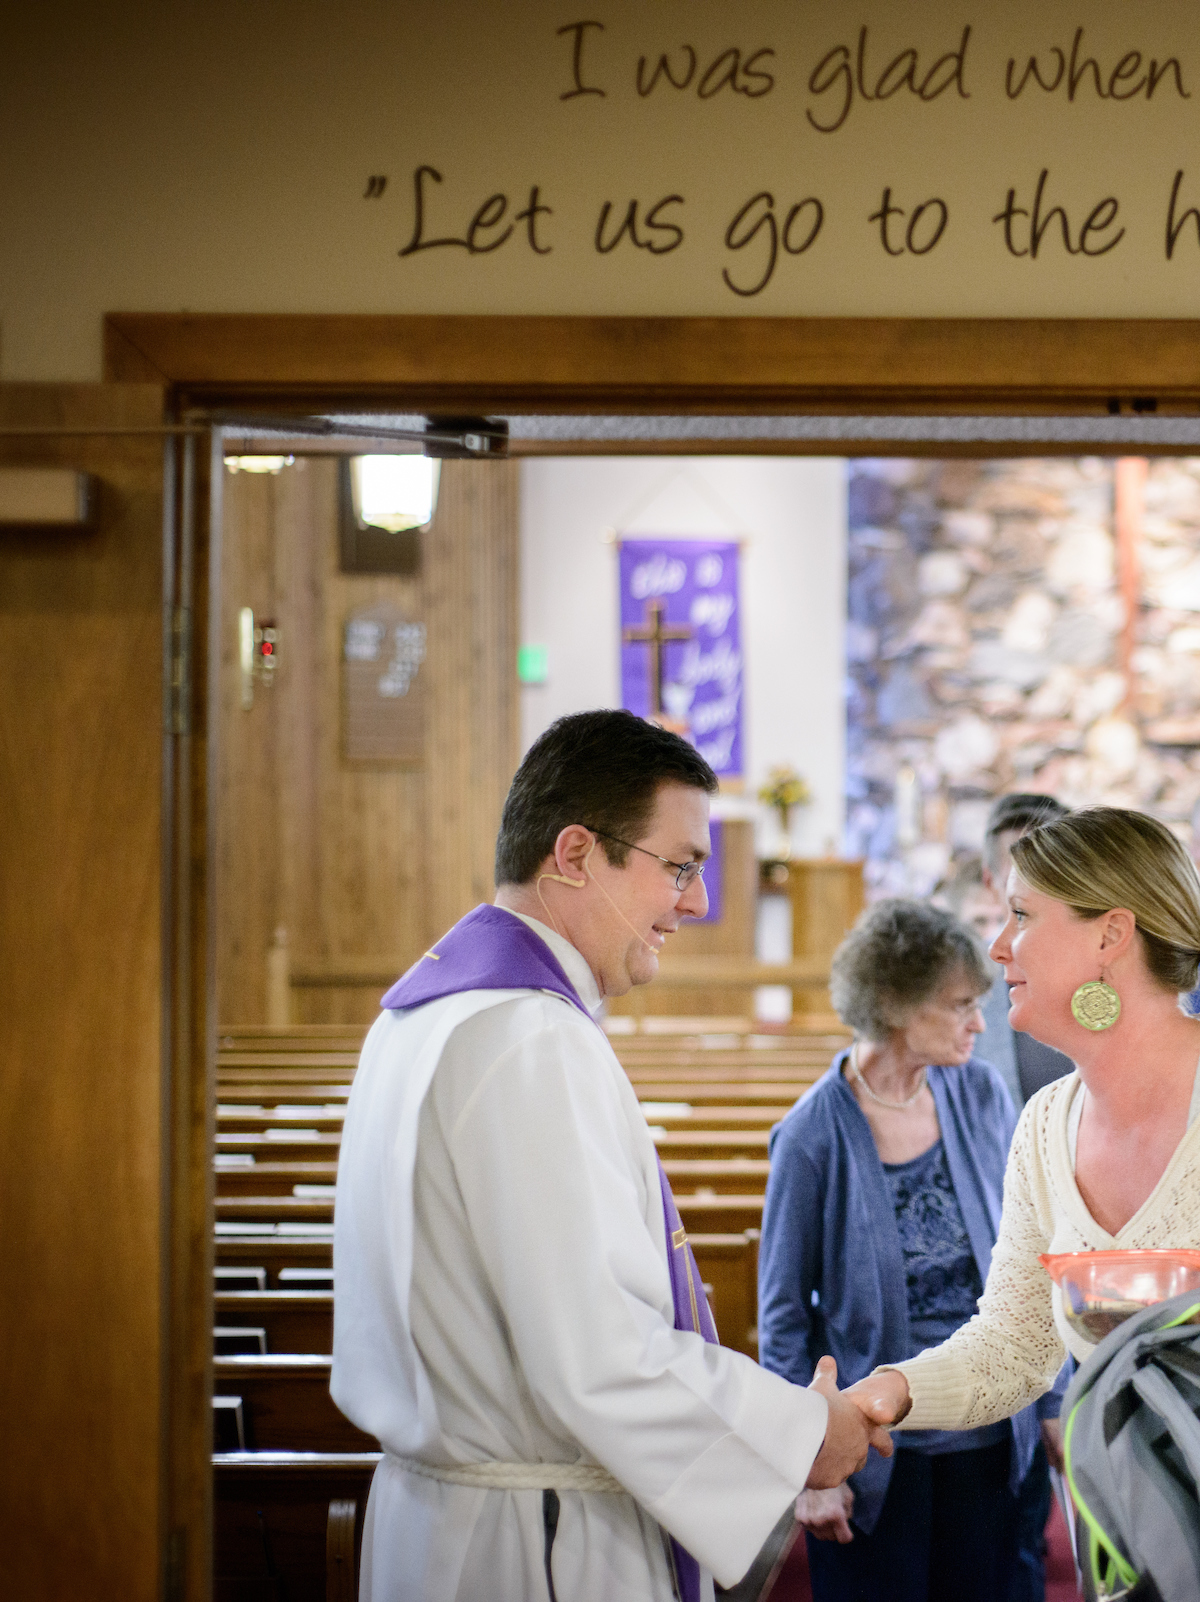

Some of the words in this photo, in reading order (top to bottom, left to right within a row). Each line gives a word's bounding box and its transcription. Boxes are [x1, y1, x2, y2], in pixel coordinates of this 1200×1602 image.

[555, 19, 607, 102] I
[634, 43, 776, 101] was
[804, 23, 973, 135] glad
[1004, 25, 1192, 103] when
[593, 192, 686, 257] us
[720, 189, 826, 299] go
[867, 185, 950, 257] to
[991, 167, 1127, 260] the
